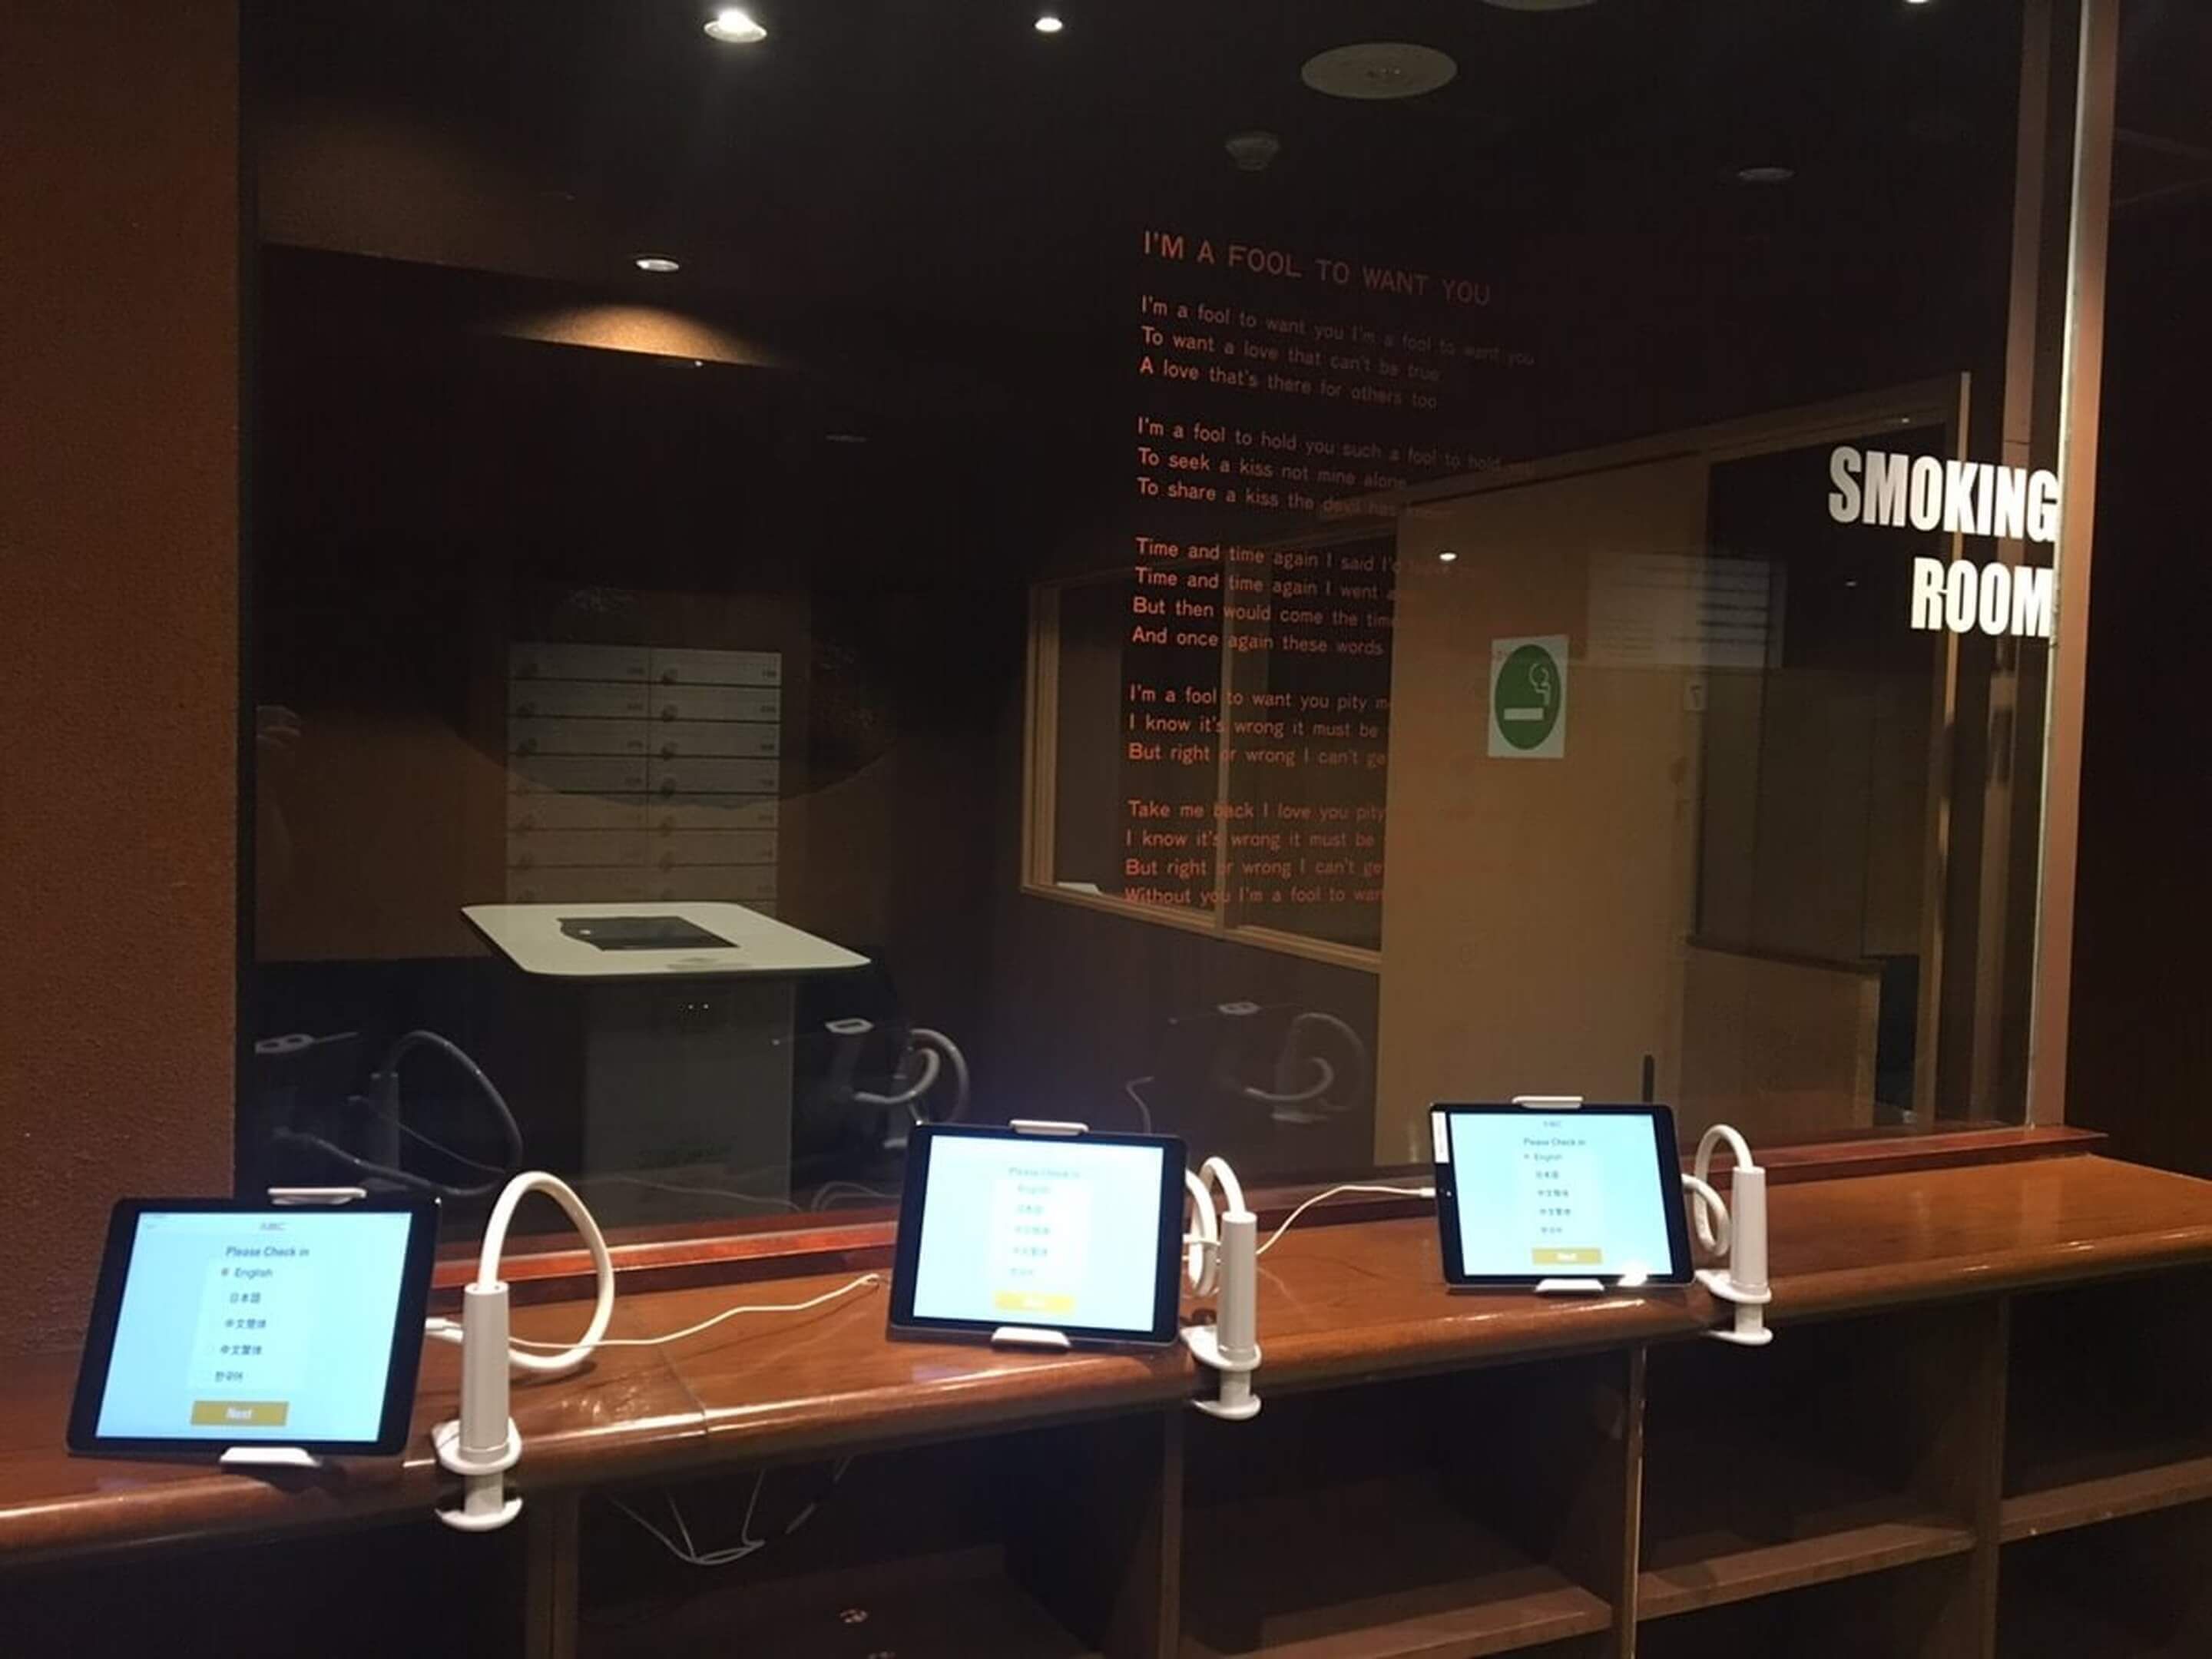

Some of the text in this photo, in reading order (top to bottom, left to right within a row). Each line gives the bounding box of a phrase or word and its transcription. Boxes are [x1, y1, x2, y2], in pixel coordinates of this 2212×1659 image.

[1144, 230, 1491, 306] I'M A FOOL TO WANT YOU
[1141, 295, 1168, 316] I'm
[1176, 304, 1189, 319] a
[1197, 303, 1230, 326] fool
[1239, 310, 1257, 328] to
[1266, 316, 1306, 335] want
[1313, 325, 1345, 341] you
[1352, 325, 1376, 344] I'm
[1383, 333, 1395, 347] a
[1402, 332, 1432, 352] fool
[1439, 338, 1457, 356] to
[1140, 325, 1164, 346] To
[1172, 333, 1215, 353] want
[1223, 341, 1235, 356] a
[1243, 339, 1280, 362] love
[1287, 346, 1323, 367] that
[1330, 353, 1371, 372] can't
[1379, 359, 1399, 377] be
[1137, 355, 1439, 411] A love that's there for others too
[1137, 415, 1165, 437] I'm
[1172, 423, 1185, 440] a
[1194, 422, 1227, 443] fool
[1235, 429, 1253, 447] to
[1260, 430, 1297, 452] hold
[1305, 440, 1336, 457] you
[1342, 441, 1382, 459] such
[1389, 448, 1401, 462] a
[1408, 445, 1439, 467] fool
[1445, 451, 1460, 469] to
[1137, 445, 1408, 492] To seek a kiss not mine alone
[1137, 475, 1160, 497] To
[1167, 479, 1217, 503] share
[1225, 488, 1237, 503] a
[1245, 487, 1280, 508] kiss
[1287, 492, 1316, 511] the
[1828, 445, 2059, 543] SMOKING
[1134, 536, 1181, 559] Time
[1187, 542, 1221, 562] and
[1230, 545, 1267, 565] time
[1273, 551, 1320, 571] again
[1326, 551, 1333, 568] I
[1340, 555, 1376, 572] said
[1134, 565, 1179, 587] Time
[1187, 573, 1220, 591] and
[1229, 574, 1264, 594] time
[1271, 578, 1319, 599] again
[1325, 579, 1331, 597] I
[1339, 584, 1379, 601] went
[1910, 557, 2055, 638] ROOM
[1132, 595, 1166, 616] But
[1175, 598, 1215, 618] then
[1223, 604, 1272, 621] would
[1280, 609, 1324, 625] come
[1332, 609, 1359, 628] the
[1131, 624, 1384, 655] And once again these words
[1129, 683, 1157, 702] I'm
[1164, 688, 1176, 704] a
[1186, 686, 1218, 704] fool
[1227, 690, 1244, 706] to
[1251, 692, 1292, 708] want
[1300, 694, 1330, 712] you
[1336, 693, 1368, 713] pity
[1128, 712, 1378, 739] I know it's wrong it must be
[1128, 742, 1358, 769] But right or wrong I can't
[1127, 799, 1385, 823] Take me back I love you pity
[1125, 829, 1375, 853] I know it's wrong it must be
[1124, 858, 1356, 880] But right or wrong I can't
[1124, 886, 1191, 905] Without
[1200, 890, 1231, 906] you
[1238, 887, 1264, 903] I'm
[1271, 890, 1282, 903] a
[1290, 887, 1322, 903] fool
[1329, 887, 1346, 903] to
[1523, 1138, 1549, 1147] Please
[1551, 1137, 1576, 1147] Check
[1534, 1152, 1562, 1162] English
[225, 1246, 310, 1258] Please Check in
[234, 1267, 273, 1280] English
[230, 1292, 261, 1304] 日本語
[226, 1407, 253, 1421] Next
